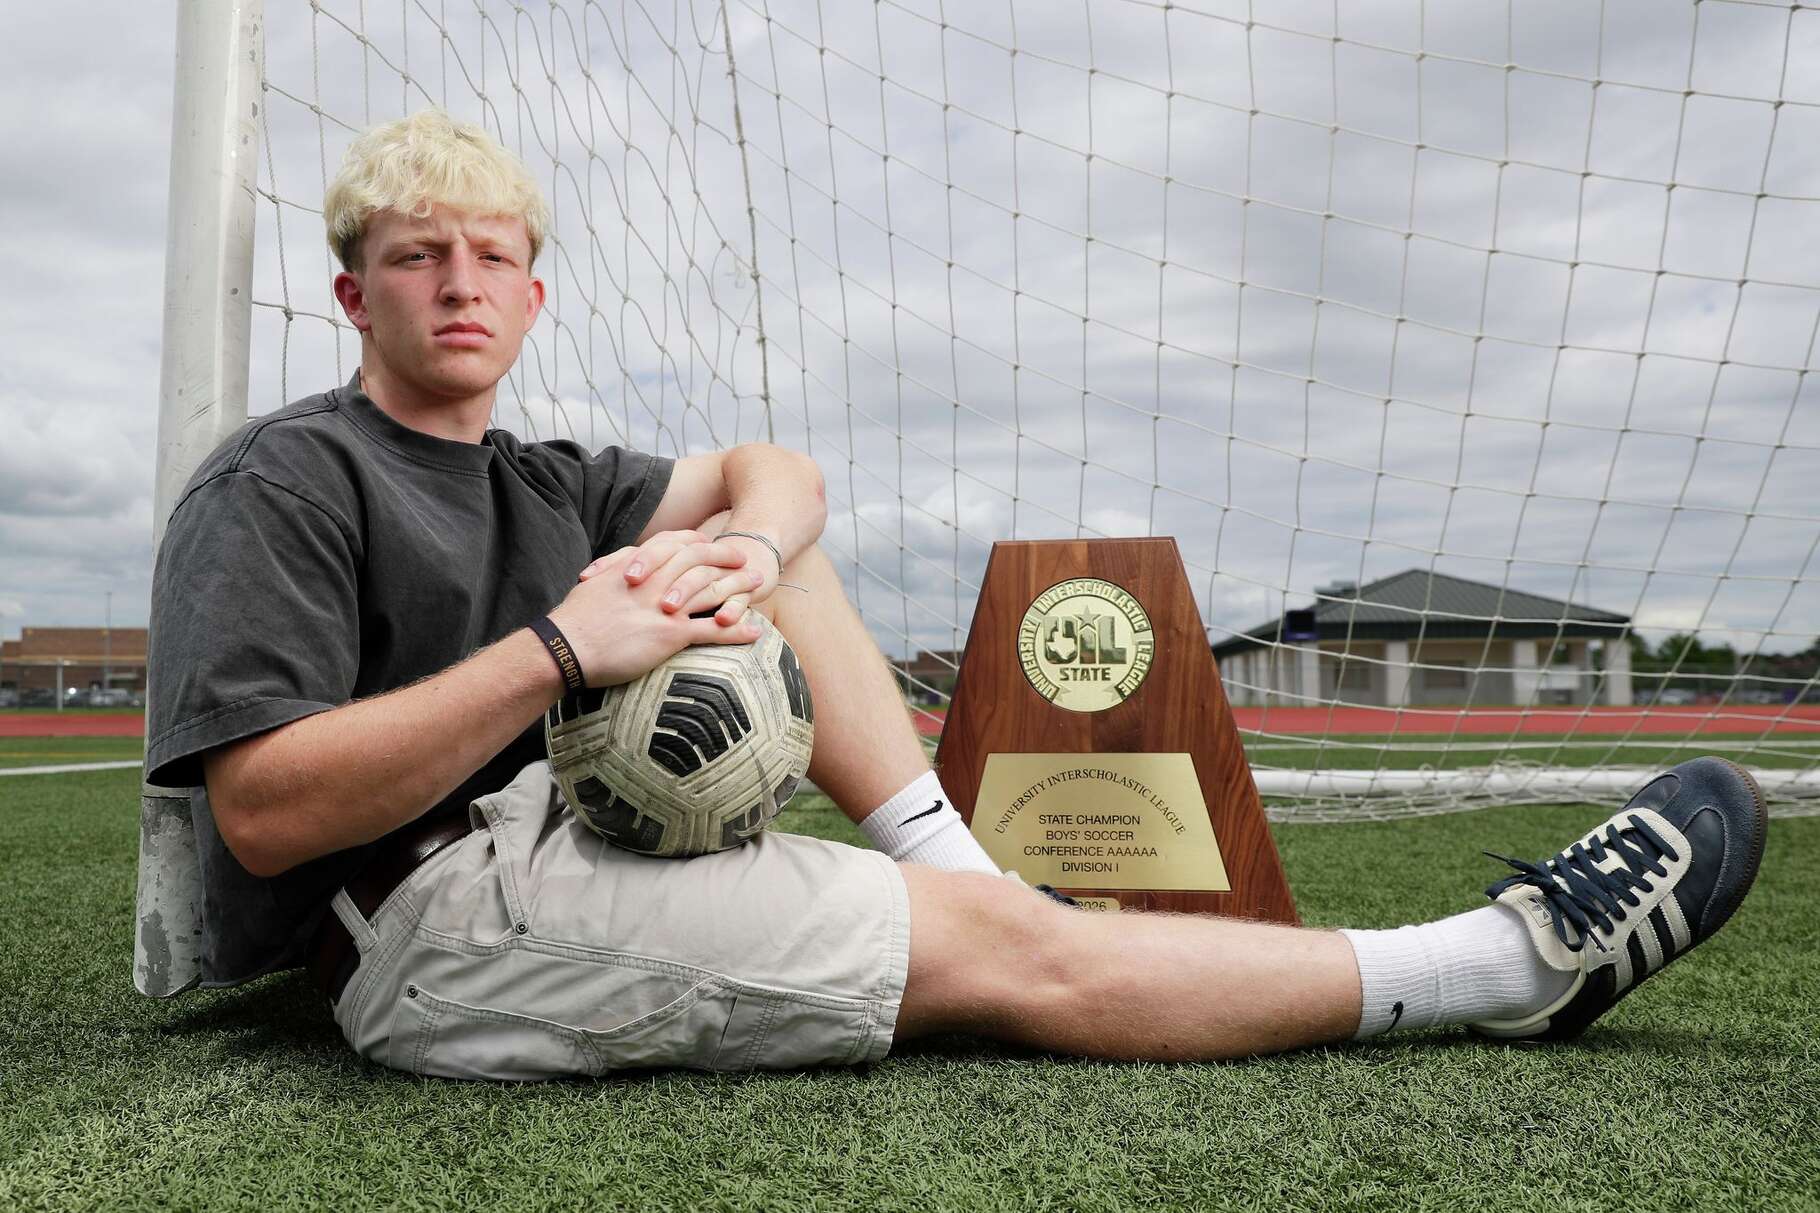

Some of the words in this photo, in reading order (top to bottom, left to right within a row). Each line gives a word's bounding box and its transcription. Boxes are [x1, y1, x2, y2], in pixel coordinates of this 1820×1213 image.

[1033, 580, 1149, 632] INTERSCHOLASTIC
[550, 637, 582, 688] STRENGTH
[1020, 615, 1058, 699] UNIVERSITY
[1044, 616, 1126, 664] UIL
[1059, 667, 1111, 681] STATE
[1116, 641, 1153, 698] LEAGUE
[995, 780, 1046, 834] UNIVERSITY
[1047, 768, 1152, 799] INTERSCHOLASTIC
[1150, 794, 1186, 835] LEAGUE
[1038, 814, 1073, 825] STATE
[1076, 814, 1141, 825] CHAMPION
[1023, 846, 1104, 857] CONFERENCE
[1106, 846, 1158, 857] AAAAAA
[1046, 830, 1080, 841] BOYS'
[1084, 830, 1134, 841] SOCCER
[1062, 862, 1113, 873] DIVISION
[1115, 863, 1119, 873] I
